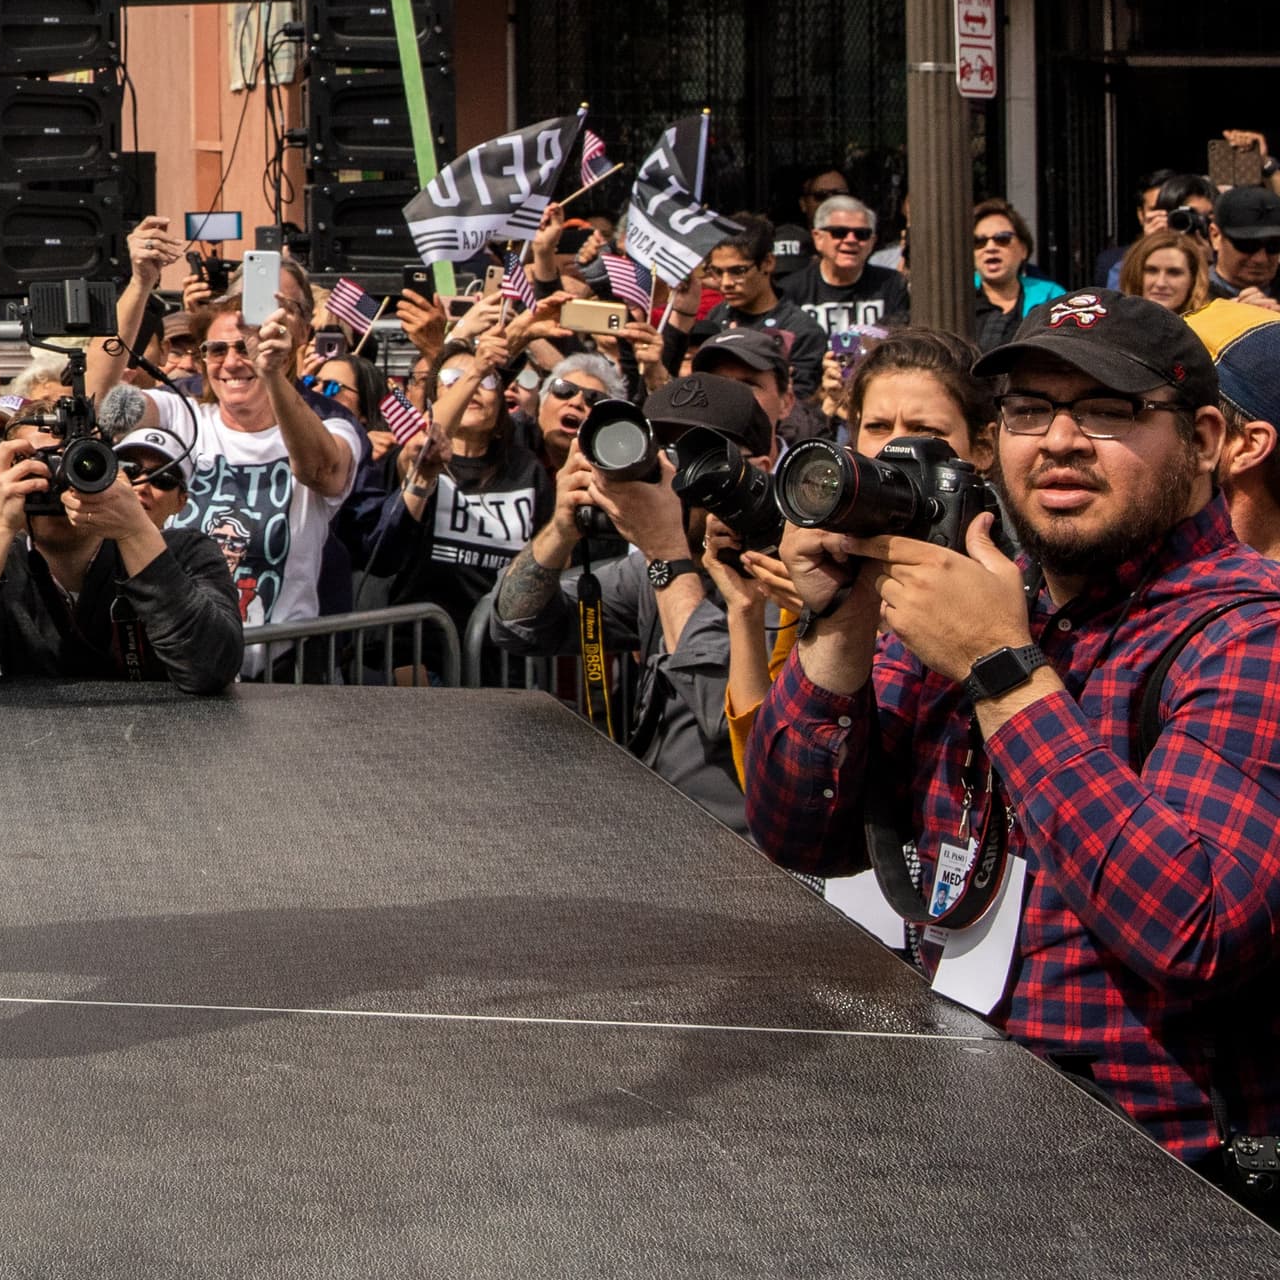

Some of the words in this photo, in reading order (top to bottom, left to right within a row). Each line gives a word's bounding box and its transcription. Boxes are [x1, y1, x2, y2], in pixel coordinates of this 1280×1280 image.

[884, 444, 912, 454] Canon
[189, 454, 292, 508] BETO
[450, 487, 534, 543] BETO
[458, 549, 479, 568] FOR
[585, 607, 596, 640] Nikon
[584, 643, 602, 681] D850
[951, 851, 965, 863] PASO
[973, 816, 1000, 889] Canon
[941, 870, 963, 887] MED
